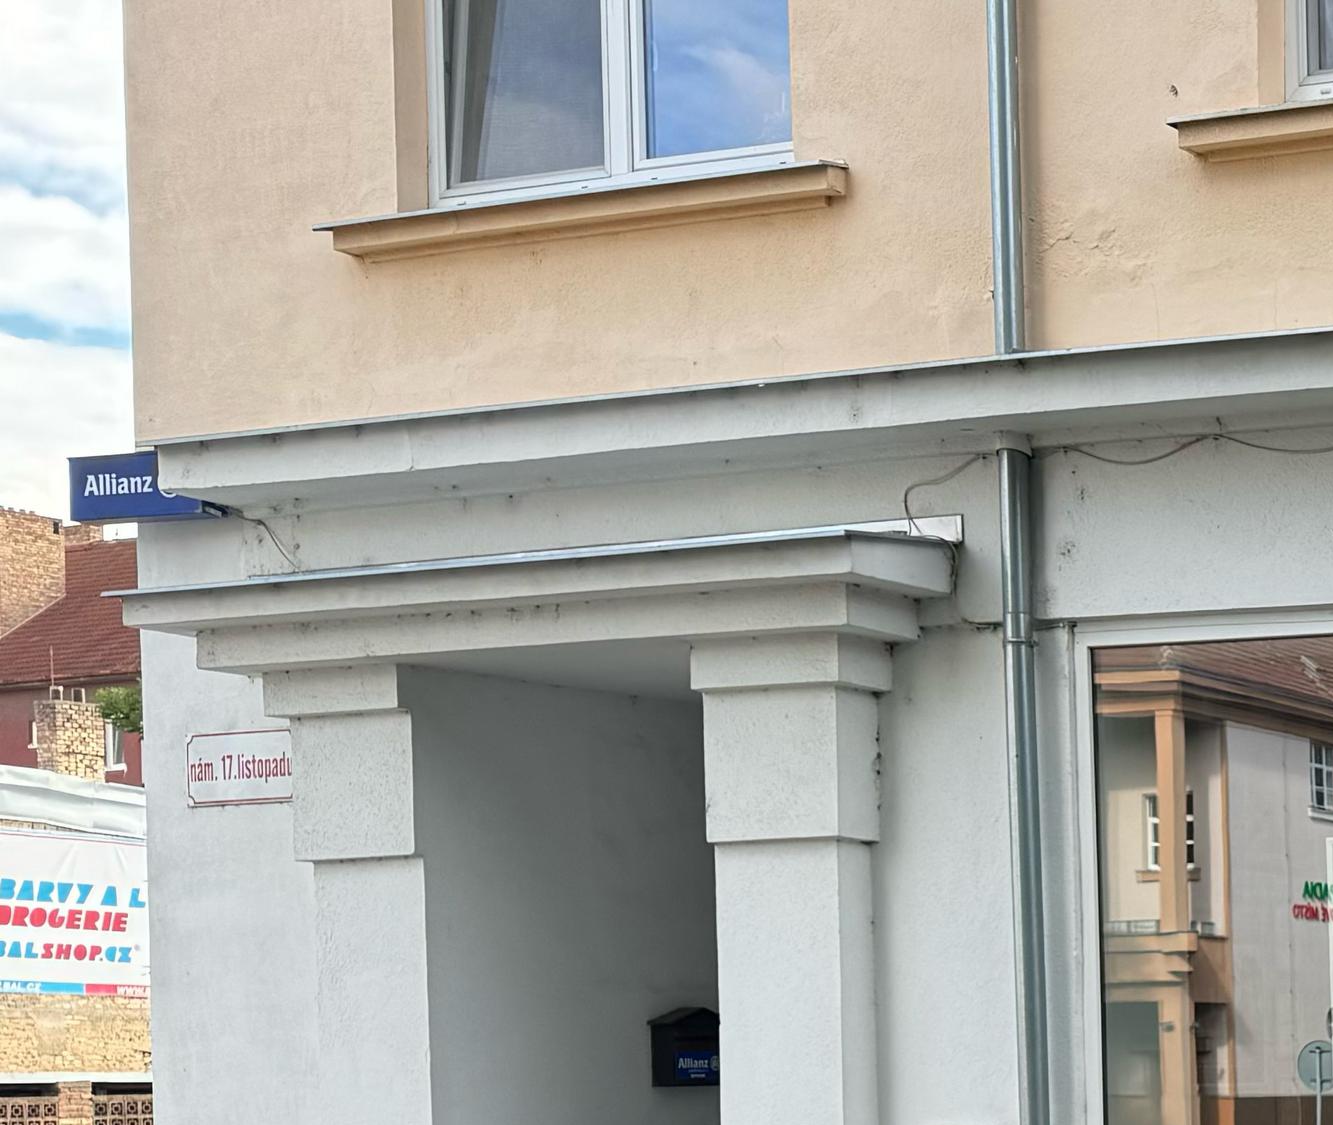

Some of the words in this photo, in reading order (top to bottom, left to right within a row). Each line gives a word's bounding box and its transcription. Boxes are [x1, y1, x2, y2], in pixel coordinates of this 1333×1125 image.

[84, 473, 153, 496] Allianz
[191, 757, 218, 782] nám.
[0, 878, 94, 905] BARVY
[100, 885, 118, 907] A
[0, 905, 128, 932] DROGERIE
[678, 1057, 709, 1069] Allianz
